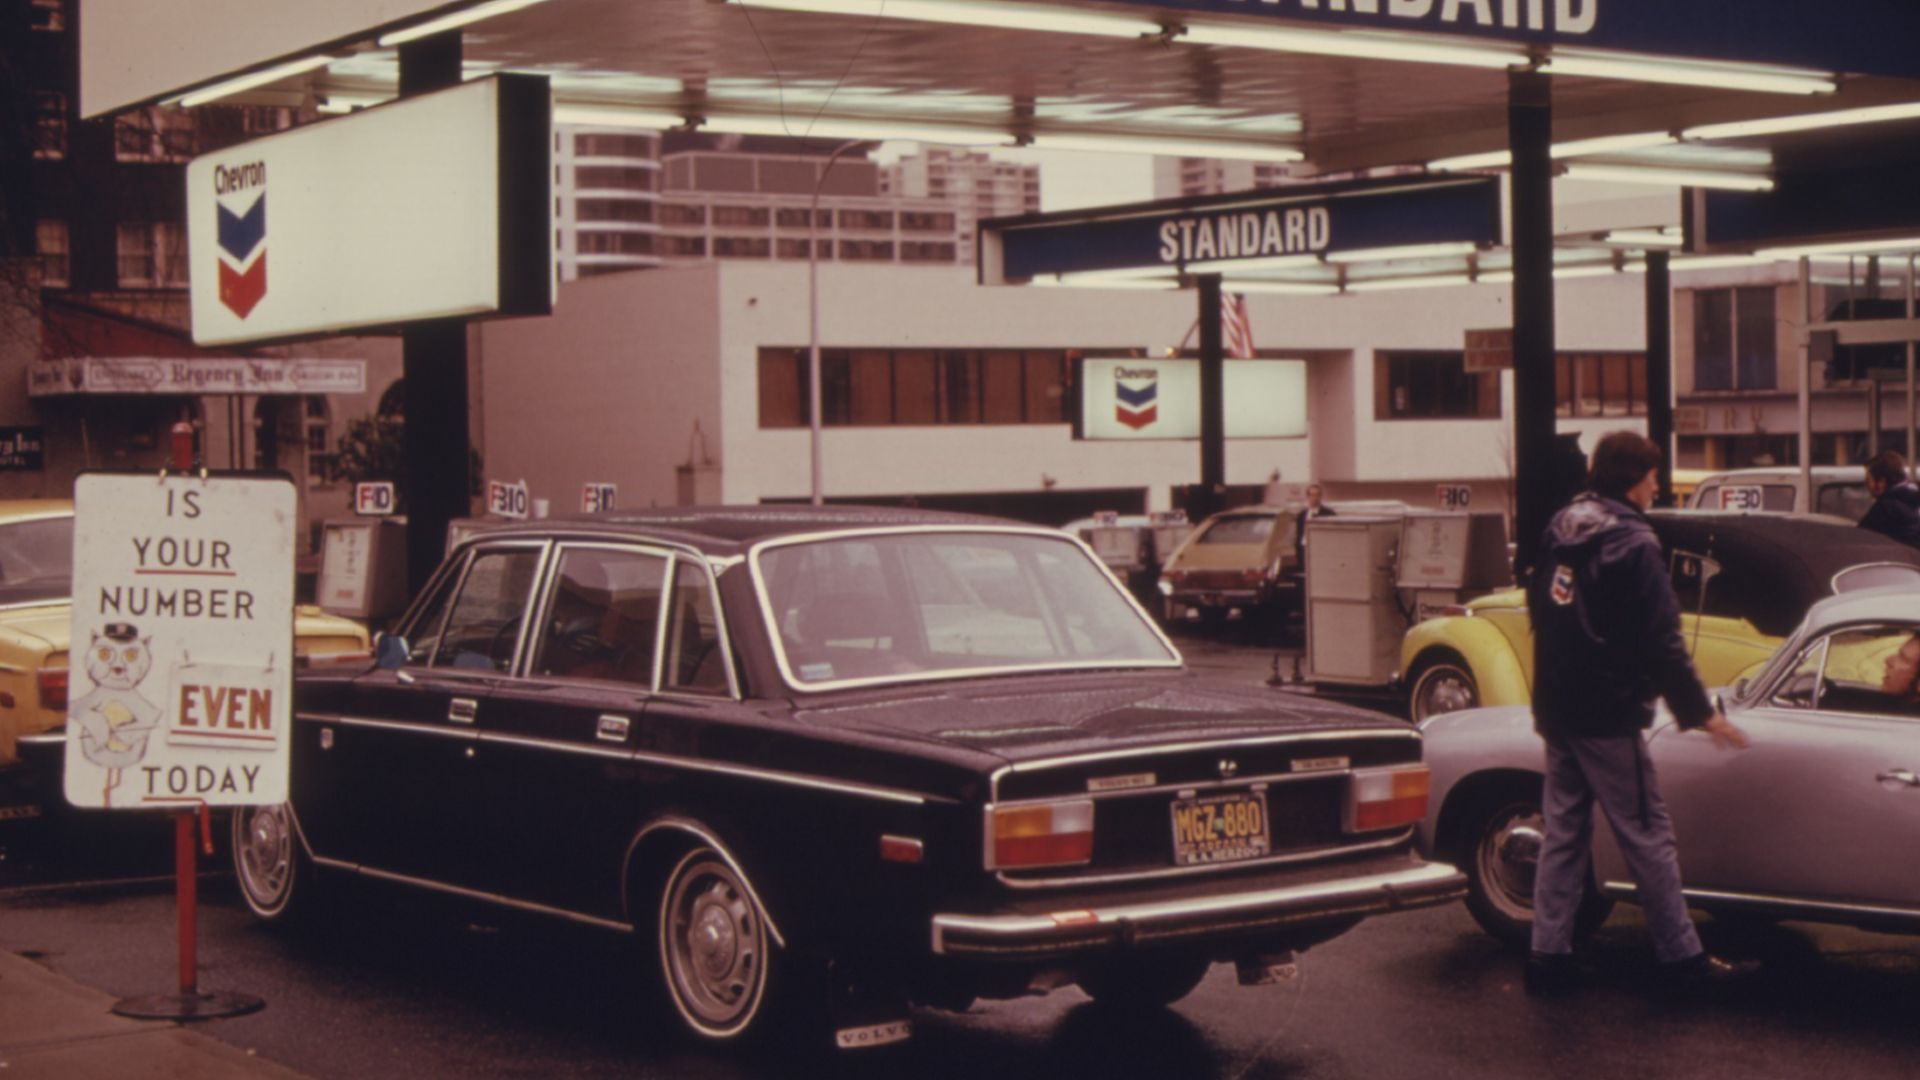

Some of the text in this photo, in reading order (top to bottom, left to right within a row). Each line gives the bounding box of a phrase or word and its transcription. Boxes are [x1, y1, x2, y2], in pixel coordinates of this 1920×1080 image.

[215, 160, 266, 194] Chevron
[1159, 206, 1331, 262] STANDARD
[1114, 366, 1157, 379] Chevron
[167, 489, 200, 518] IS
[132, 537, 231, 568] YOUR
[100, 586, 254, 619] NUMBER
[179, 684, 272, 729] EVEN
[142, 765, 260, 793] TODAY
[842, 1024, 912, 1044] VOLVO
